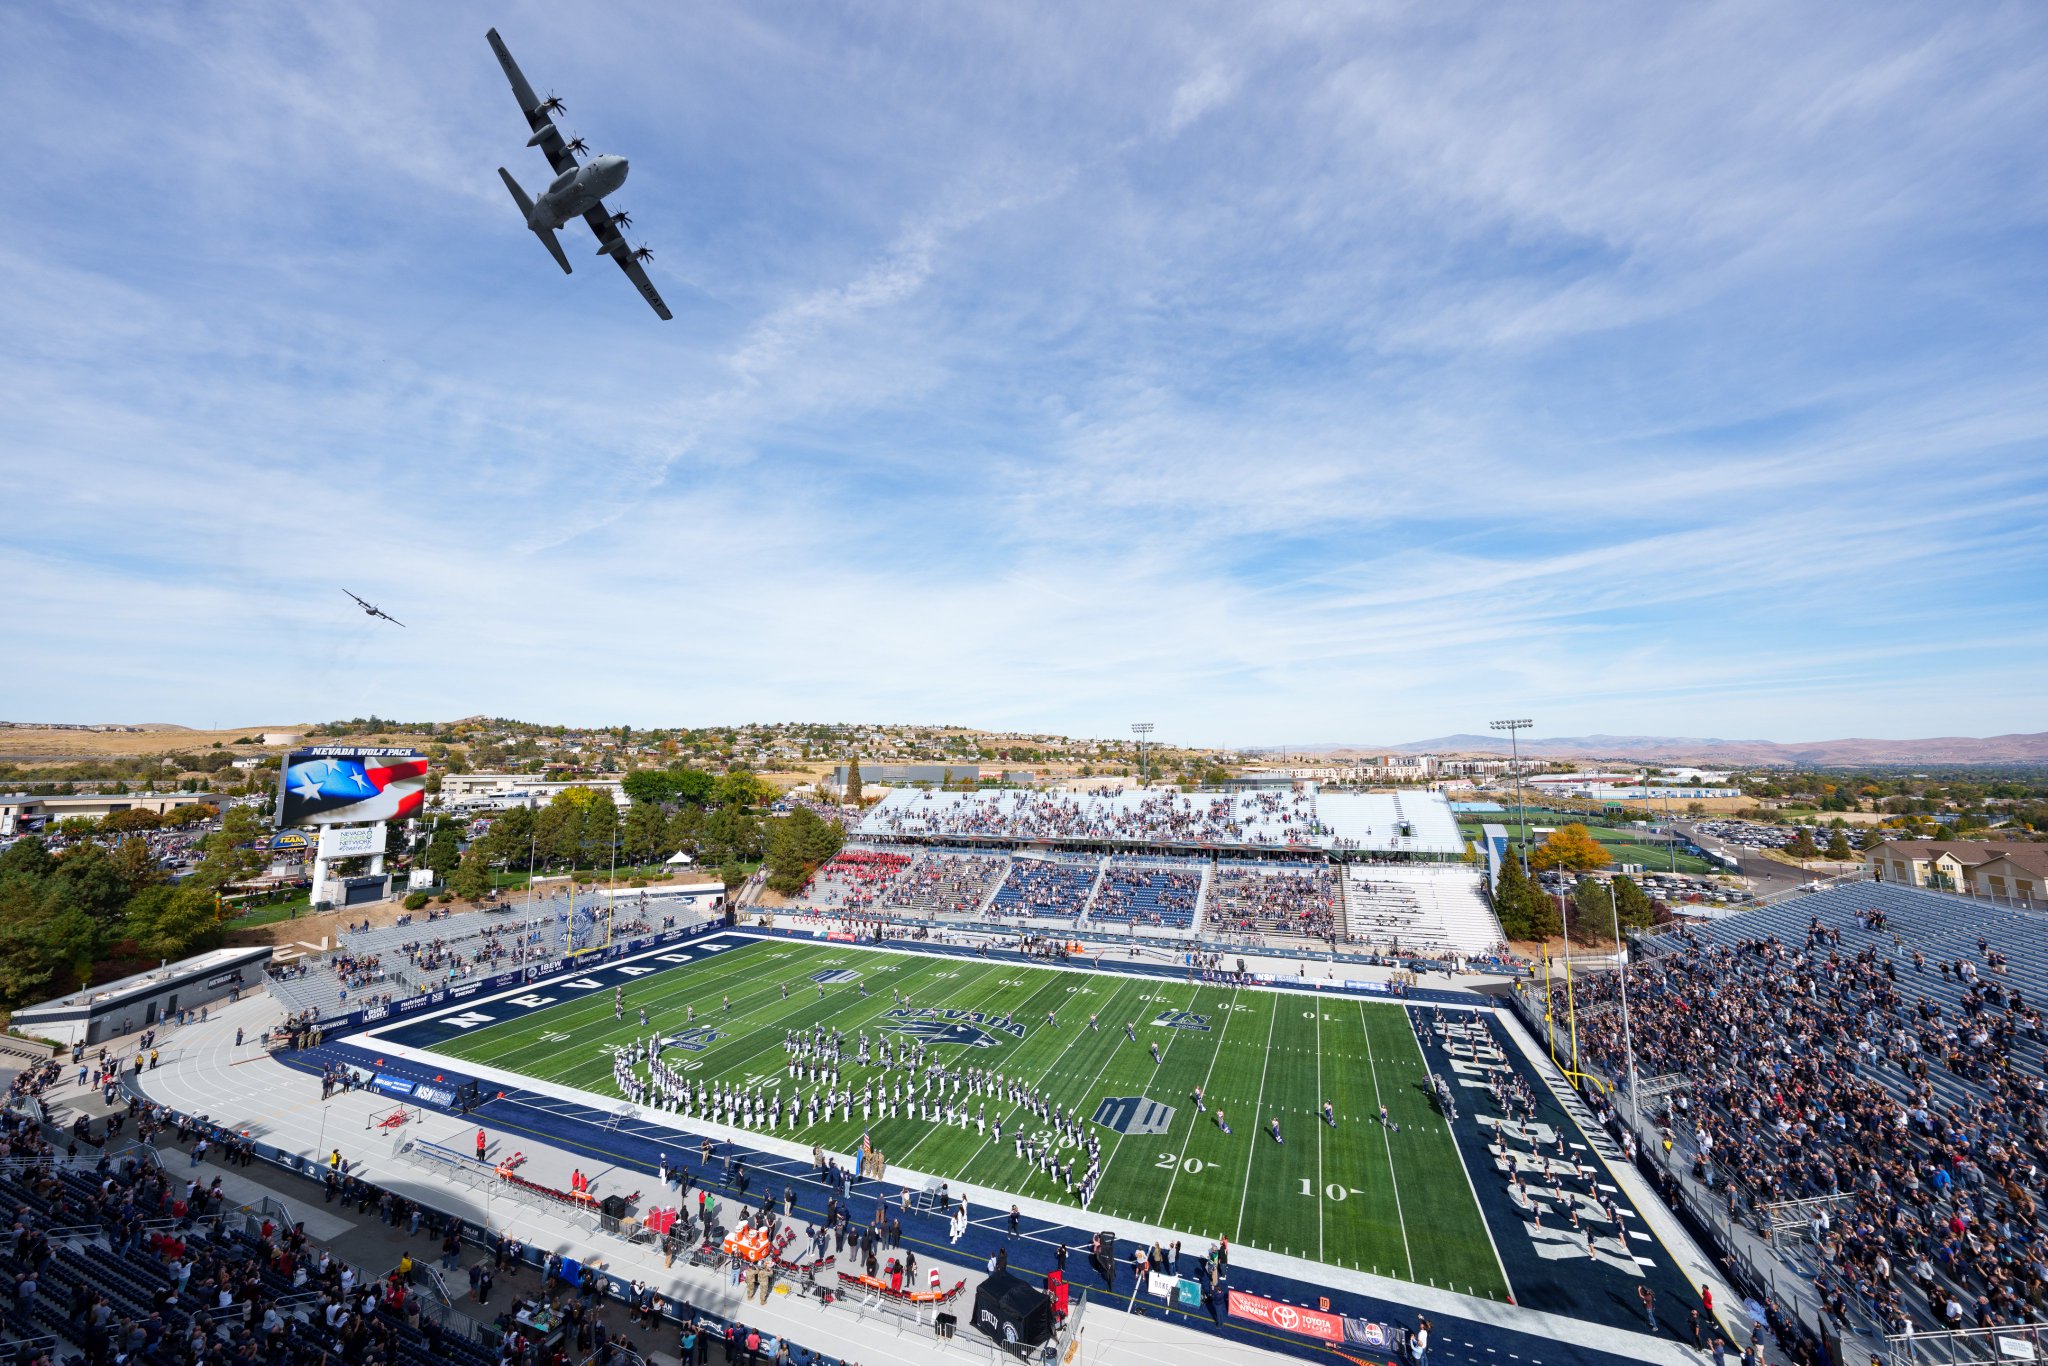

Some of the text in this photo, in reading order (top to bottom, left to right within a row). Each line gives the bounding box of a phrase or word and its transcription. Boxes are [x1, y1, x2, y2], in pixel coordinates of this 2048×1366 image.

[643, 283, 665, 308] USAF
[311, 747, 412, 756] NEVADA WOLF PACK
[540, 960, 562, 971] IBEW
[538, 968, 554, 976] LOCAL
[439, 944, 732, 1029] NEVADA
[450, 981, 482, 994] Panasonic
[455, 987, 477, 997] ENERGY
[1066, 986, 1094, 995] 40
[401, 996, 427, 1008] nutrient
[1139, 994, 1168, 1004] 30
[367, 1007, 385, 1016] BUD
[400, 1002, 427, 1011] SURVIVAL
[1217, 1003, 1248, 1012] 20
[364, 1011, 387, 1021] LIGHT
[1302, 1011, 1333, 1021] 10
[878, 1008, 1027, 1038] NEVADA
[537, 1032, 571, 1042] 10
[745, 1074, 782, 1088] 40
[414, 1086, 435, 1102] NSN
[1155, 1153, 1203, 1174] 20
[1298, 1178, 1347, 1201] 10
[1474, 1114, 1646, 1278] PACK
[748, 1250, 755, 1259] G
[1240, 1305, 1269, 1318] NEVADA
[981, 1309, 999, 1330] UNLV
[1302, 1315, 1331, 1328] TOYOTA
[1303, 1323, 1332, 1334] DEALERS
